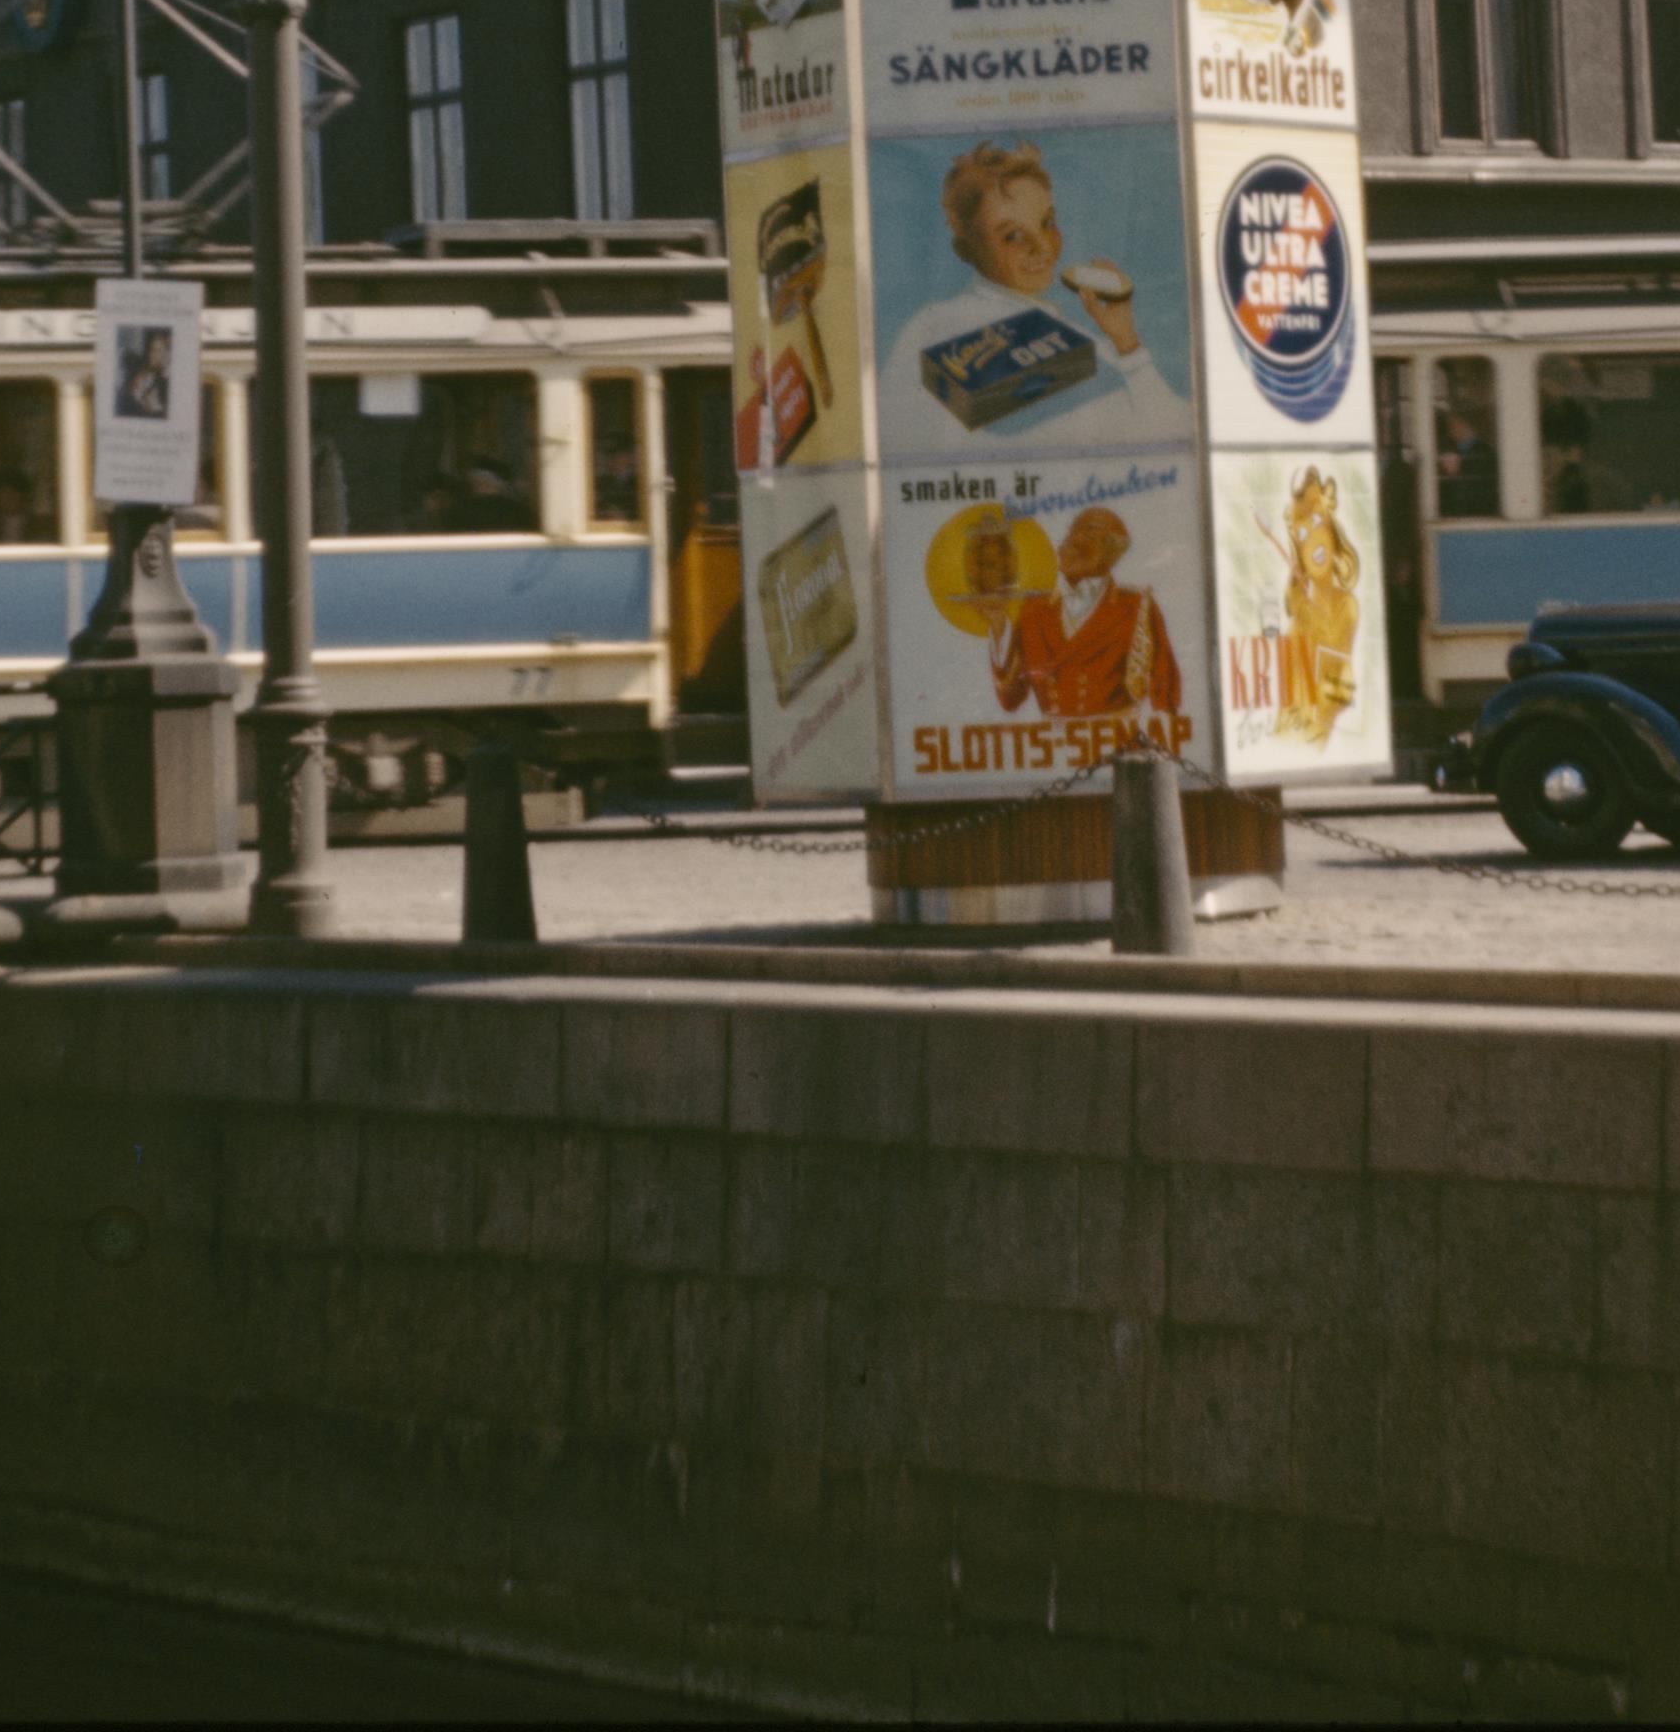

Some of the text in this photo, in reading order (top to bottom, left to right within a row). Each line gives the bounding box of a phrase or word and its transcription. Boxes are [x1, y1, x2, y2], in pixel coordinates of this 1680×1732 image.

[889, 37, 1150, 85] SÄNGKLÄDER
[1198, 49, 1346, 112] cirkelkaffe
[1238, 191, 1323, 230] NIVEA
[1239, 231, 1325, 269] ULTRA
[1242, 270, 1329, 308] CREME
[1010, 331, 1070, 367] OST
[901, 471, 996, 504] smaken
[1014, 470, 1040, 497] är
[913, 715, 1193, 774] SLOTTS-SENAP
